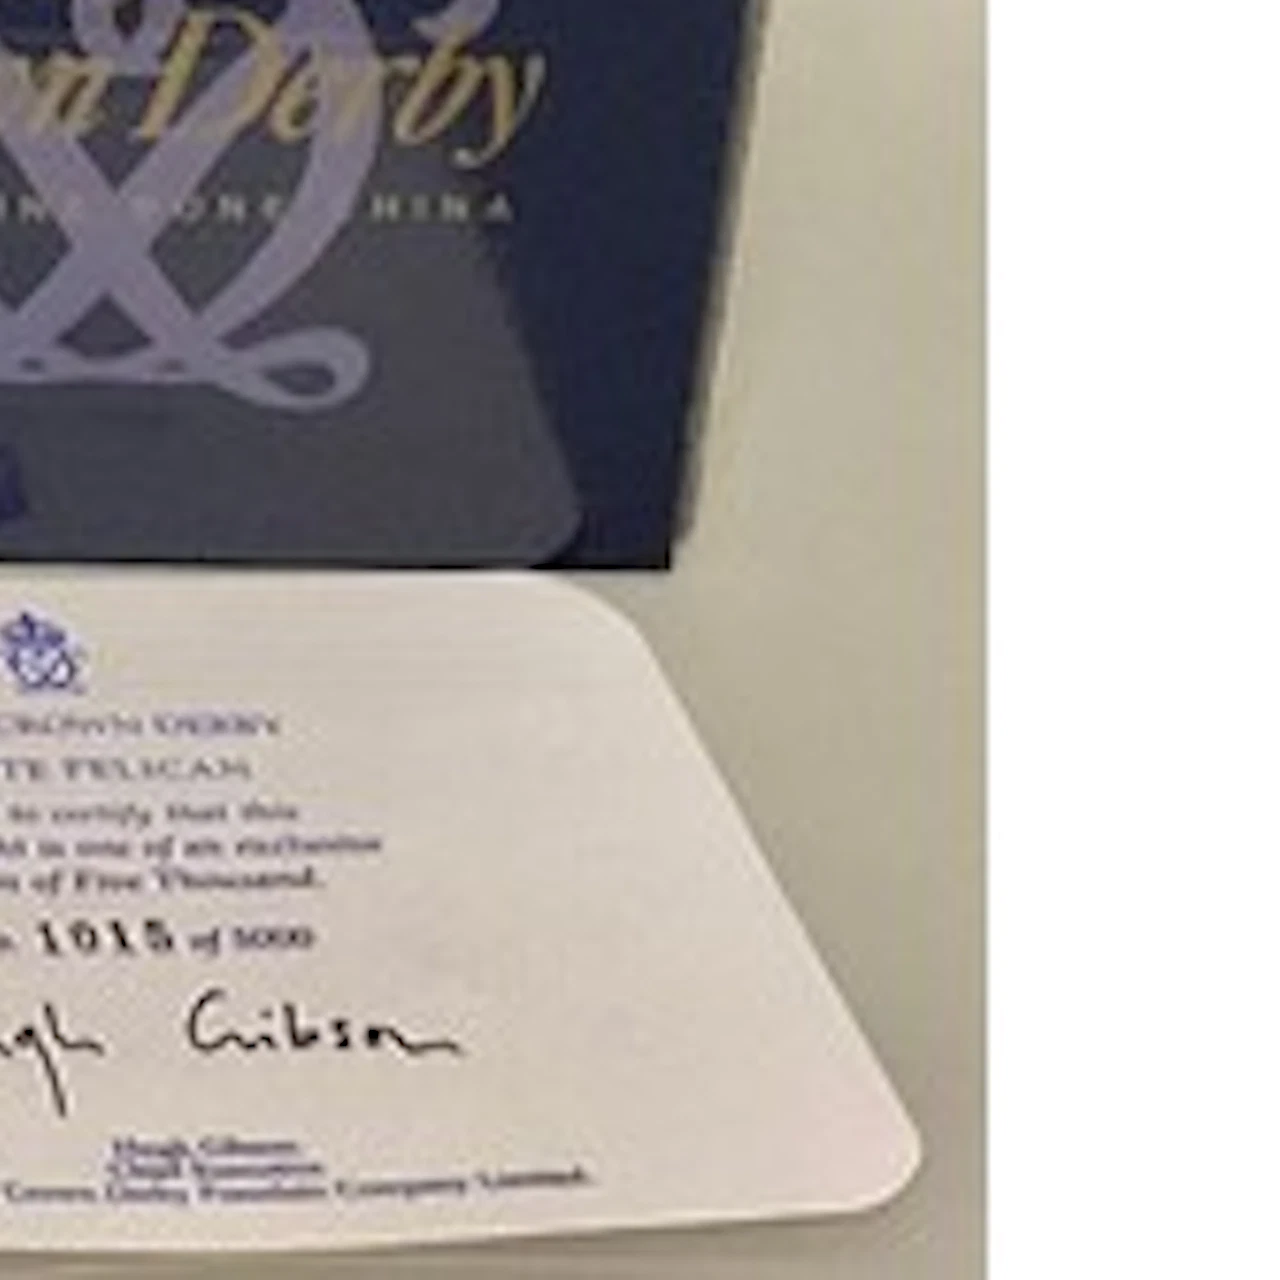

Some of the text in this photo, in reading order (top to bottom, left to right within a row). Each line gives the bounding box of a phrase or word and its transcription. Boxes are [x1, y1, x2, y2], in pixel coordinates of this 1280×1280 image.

[133, 8, 546, 167] Derby
[178, 190, 296, 224] ONE
[372, 190, 515, 222] HINA
[152, 712, 280, 735] DERBY
[60, 756, 252, 781] PELICAN
[8, 802, 40, 822] to
[50, 802, 152, 829] certify
[165, 801, 227, 822] that
[241, 799, 298, 821] this
[29, 867, 61, 894] of
[75, 868, 141, 893] Five
[38, 920, 175, 957] 1015
[192, 926, 220, 958] of
[235, 925, 316, 951] 5000
[185, 989, 466, 1056] Gibson
